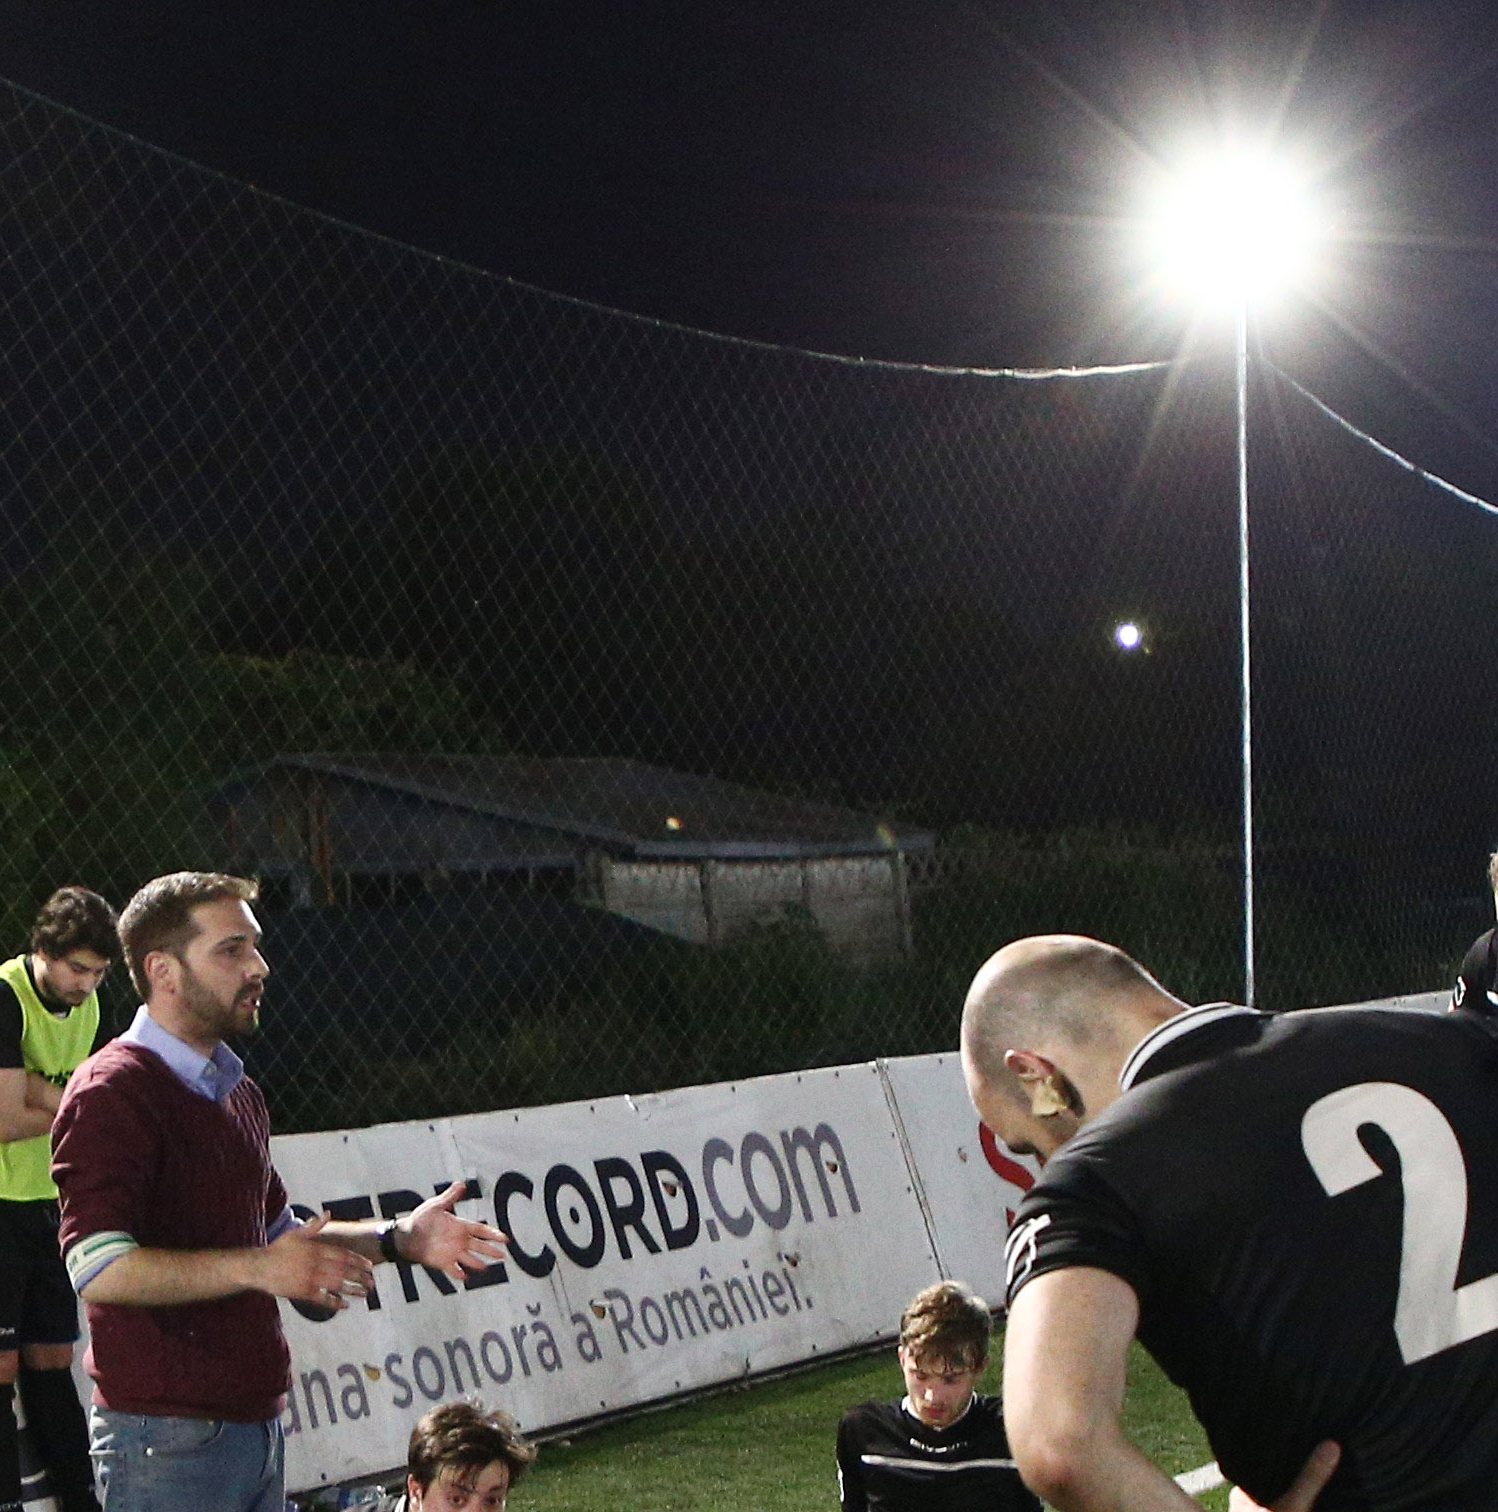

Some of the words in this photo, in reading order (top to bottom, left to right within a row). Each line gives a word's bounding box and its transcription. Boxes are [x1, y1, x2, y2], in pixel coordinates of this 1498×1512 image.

[384, 1302, 563, 1410] sonoră
[571, 1312, 603, 1363] a
[603, 1252, 814, 1354] României.
